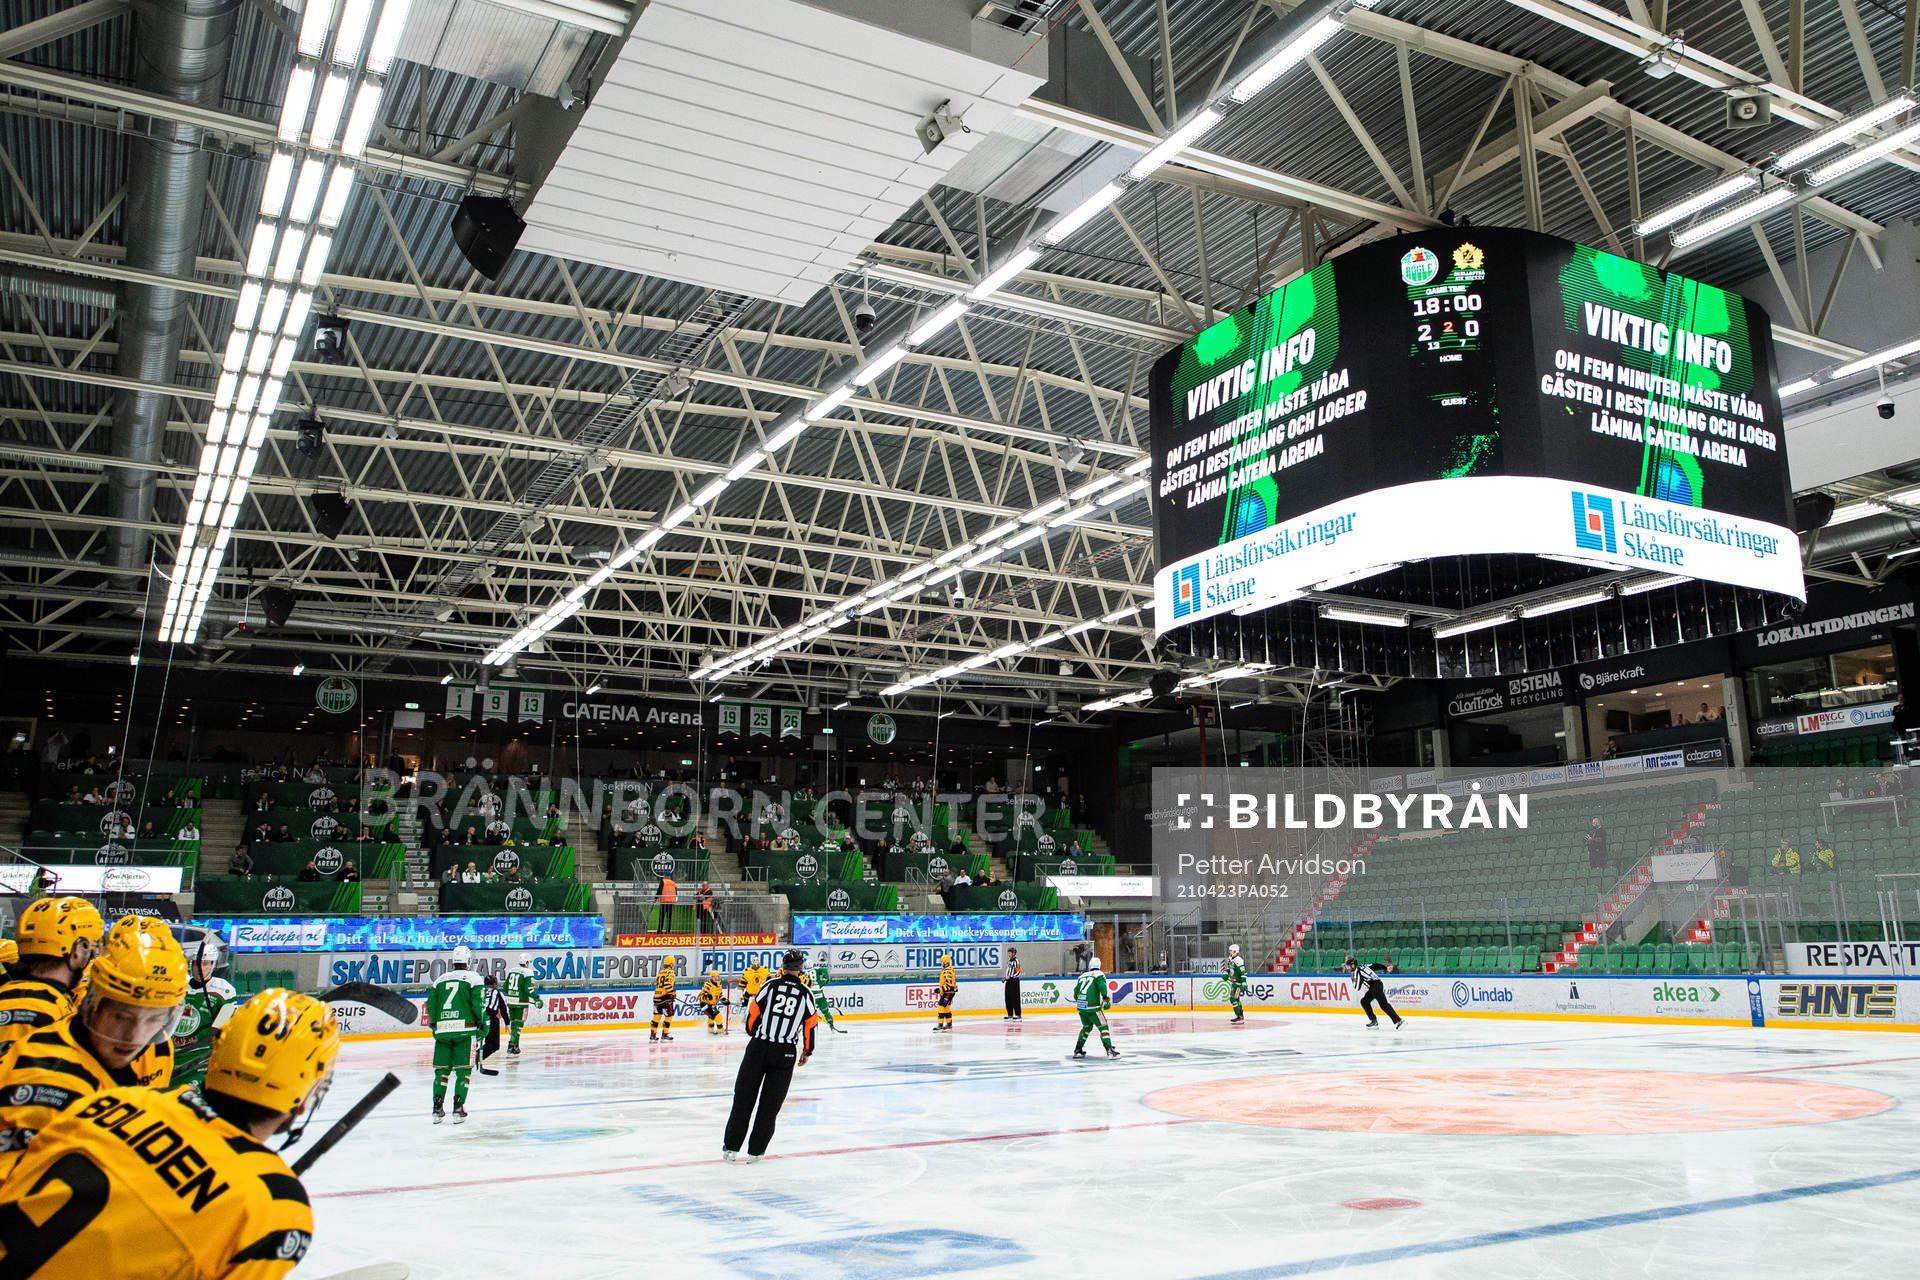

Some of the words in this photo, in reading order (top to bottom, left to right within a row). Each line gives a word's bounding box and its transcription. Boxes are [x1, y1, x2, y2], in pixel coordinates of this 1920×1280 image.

[1413, 294, 1482, 316] 18:00
[1418, 324, 1432, 341] 2
[1443, 321, 1454, 332] 2
[1465, 320, 1480, 336] 0
[1584, 301, 1669, 356] VIKTIG
[1677, 329, 1732, 374] INFO
[1428, 341, 1440, 350] 13
[1460, 339, 1467, 347] 7
[1439, 353, 1463, 362] HOME
[1187, 359, 1255, 420] VIKTIG
[1261, 328, 1316, 385] INFO
[1555, 349, 1580, 374] OM
[1583, 353, 1612, 380] FEM
[1617, 358, 1681, 399] MINUTER
[1683, 381, 1729, 413] MÅSTE
[1730, 393, 1764, 422] VÅRA
[1441, 397, 1468, 406] GUEST
[1166, 444, 1182, 469] OM
[1184, 434, 1207, 460] FEM
[1209, 409, 1262, 449] MINUTER
[1265, 387, 1308, 424] MÅSTE
[1311, 368, 1349, 402] VÅRA
[1541, 371, 1602, 406] GÄSTER
[1606, 387, 1612, 408] I
[1615, 390, 1707, 432] RESTAURANG
[1709, 415, 1737, 441] OCH
[1739, 424, 1777, 452] LOGER
[1160, 463, 1198, 497] GÄSTER
[1200, 459, 1205, 479] I
[1206, 425, 1285, 476] RESTAURANG
[1287, 410, 1317, 440] OCH
[1318, 390, 1368, 427] LOGER
[1591, 411, 1643, 444] LÄMNA
[1646, 425, 1699, 457] CATENA
[1701, 439, 1747, 468] ARENA
[1186, 474, 1228, 509] LÄMNA
[1229, 454, 1277, 491] CATENA
[1278, 434, 1325, 471] ARENA
[1620, 501, 1779, 559] Länsförsäkringar
[1205, 510, 1357, 581] Länsförsäkringar
[1624, 533, 1685, 566] Skåne
[1206, 575, 1256, 609] Skåne
[1757, 602, 1915, 647] LOKALTIDNINGEN
[1520, 671, 1562, 692] STENA
[1596, 672, 1619, 687] Bjäre
[1619, 666, 1645, 680] Kraft
[455, 694, 463, 708] 1
[491, 696, 501, 710] 9
[523, 698, 539, 712] 13
[1510, 688, 1564, 706] RECYCLING
[562, 702, 641, 723] CATENA
[646, 707, 703, 726] Arena
[723, 710, 736, 724] 19
[753, 713, 769, 726] 25
[783, 714, 799, 728] 26
[1820, 711, 1845, 722] BYGG
[1800, 715, 1820, 733] LM
[602, 781, 641, 792] sektion
[360, 757, 791, 841] BRÄNNBORN
[814, 789, 1049, 843] CENTER
[316, 858, 340, 867] ARENA
[266, 900, 291, 909] ARENA
[508, 900, 529, 908] ARENA
[368, 932, 386, 945] al
[543, 931, 571, 943] över
[635, 936, 714, 946] FLAGGFABRIKEN
[717, 935, 759, 945] KRONAN
[895, 928, 914, 938] Ditt
[916, 928, 931, 937] val
[905, 947, 999, 968] FRIBROCKS
[331, 955, 508, 985] SKÅNEPOAR
[508, 973, 520, 990] 91
[1135, 980, 1175, 991] INTER
[443, 981, 459, 1010] 7
[828, 993, 864, 1008] avida
[909, 986, 941, 1001] ER-H
[1135, 992, 1174, 1004] SPORT
[1290, 982, 1351, 1001] CATENA
[1471, 986, 1513, 1002] Lindab
[1652, 981, 1700, 1002] akea
[331, 1005, 366, 1017] esurs
[548, 995, 639, 1012] FLYTGOLV
[772, 994, 798, 1018] 28
[553, 1013, 620, 1022] LANDSKRONA
[76, 1096, 231, 1214] BOLIDEN
